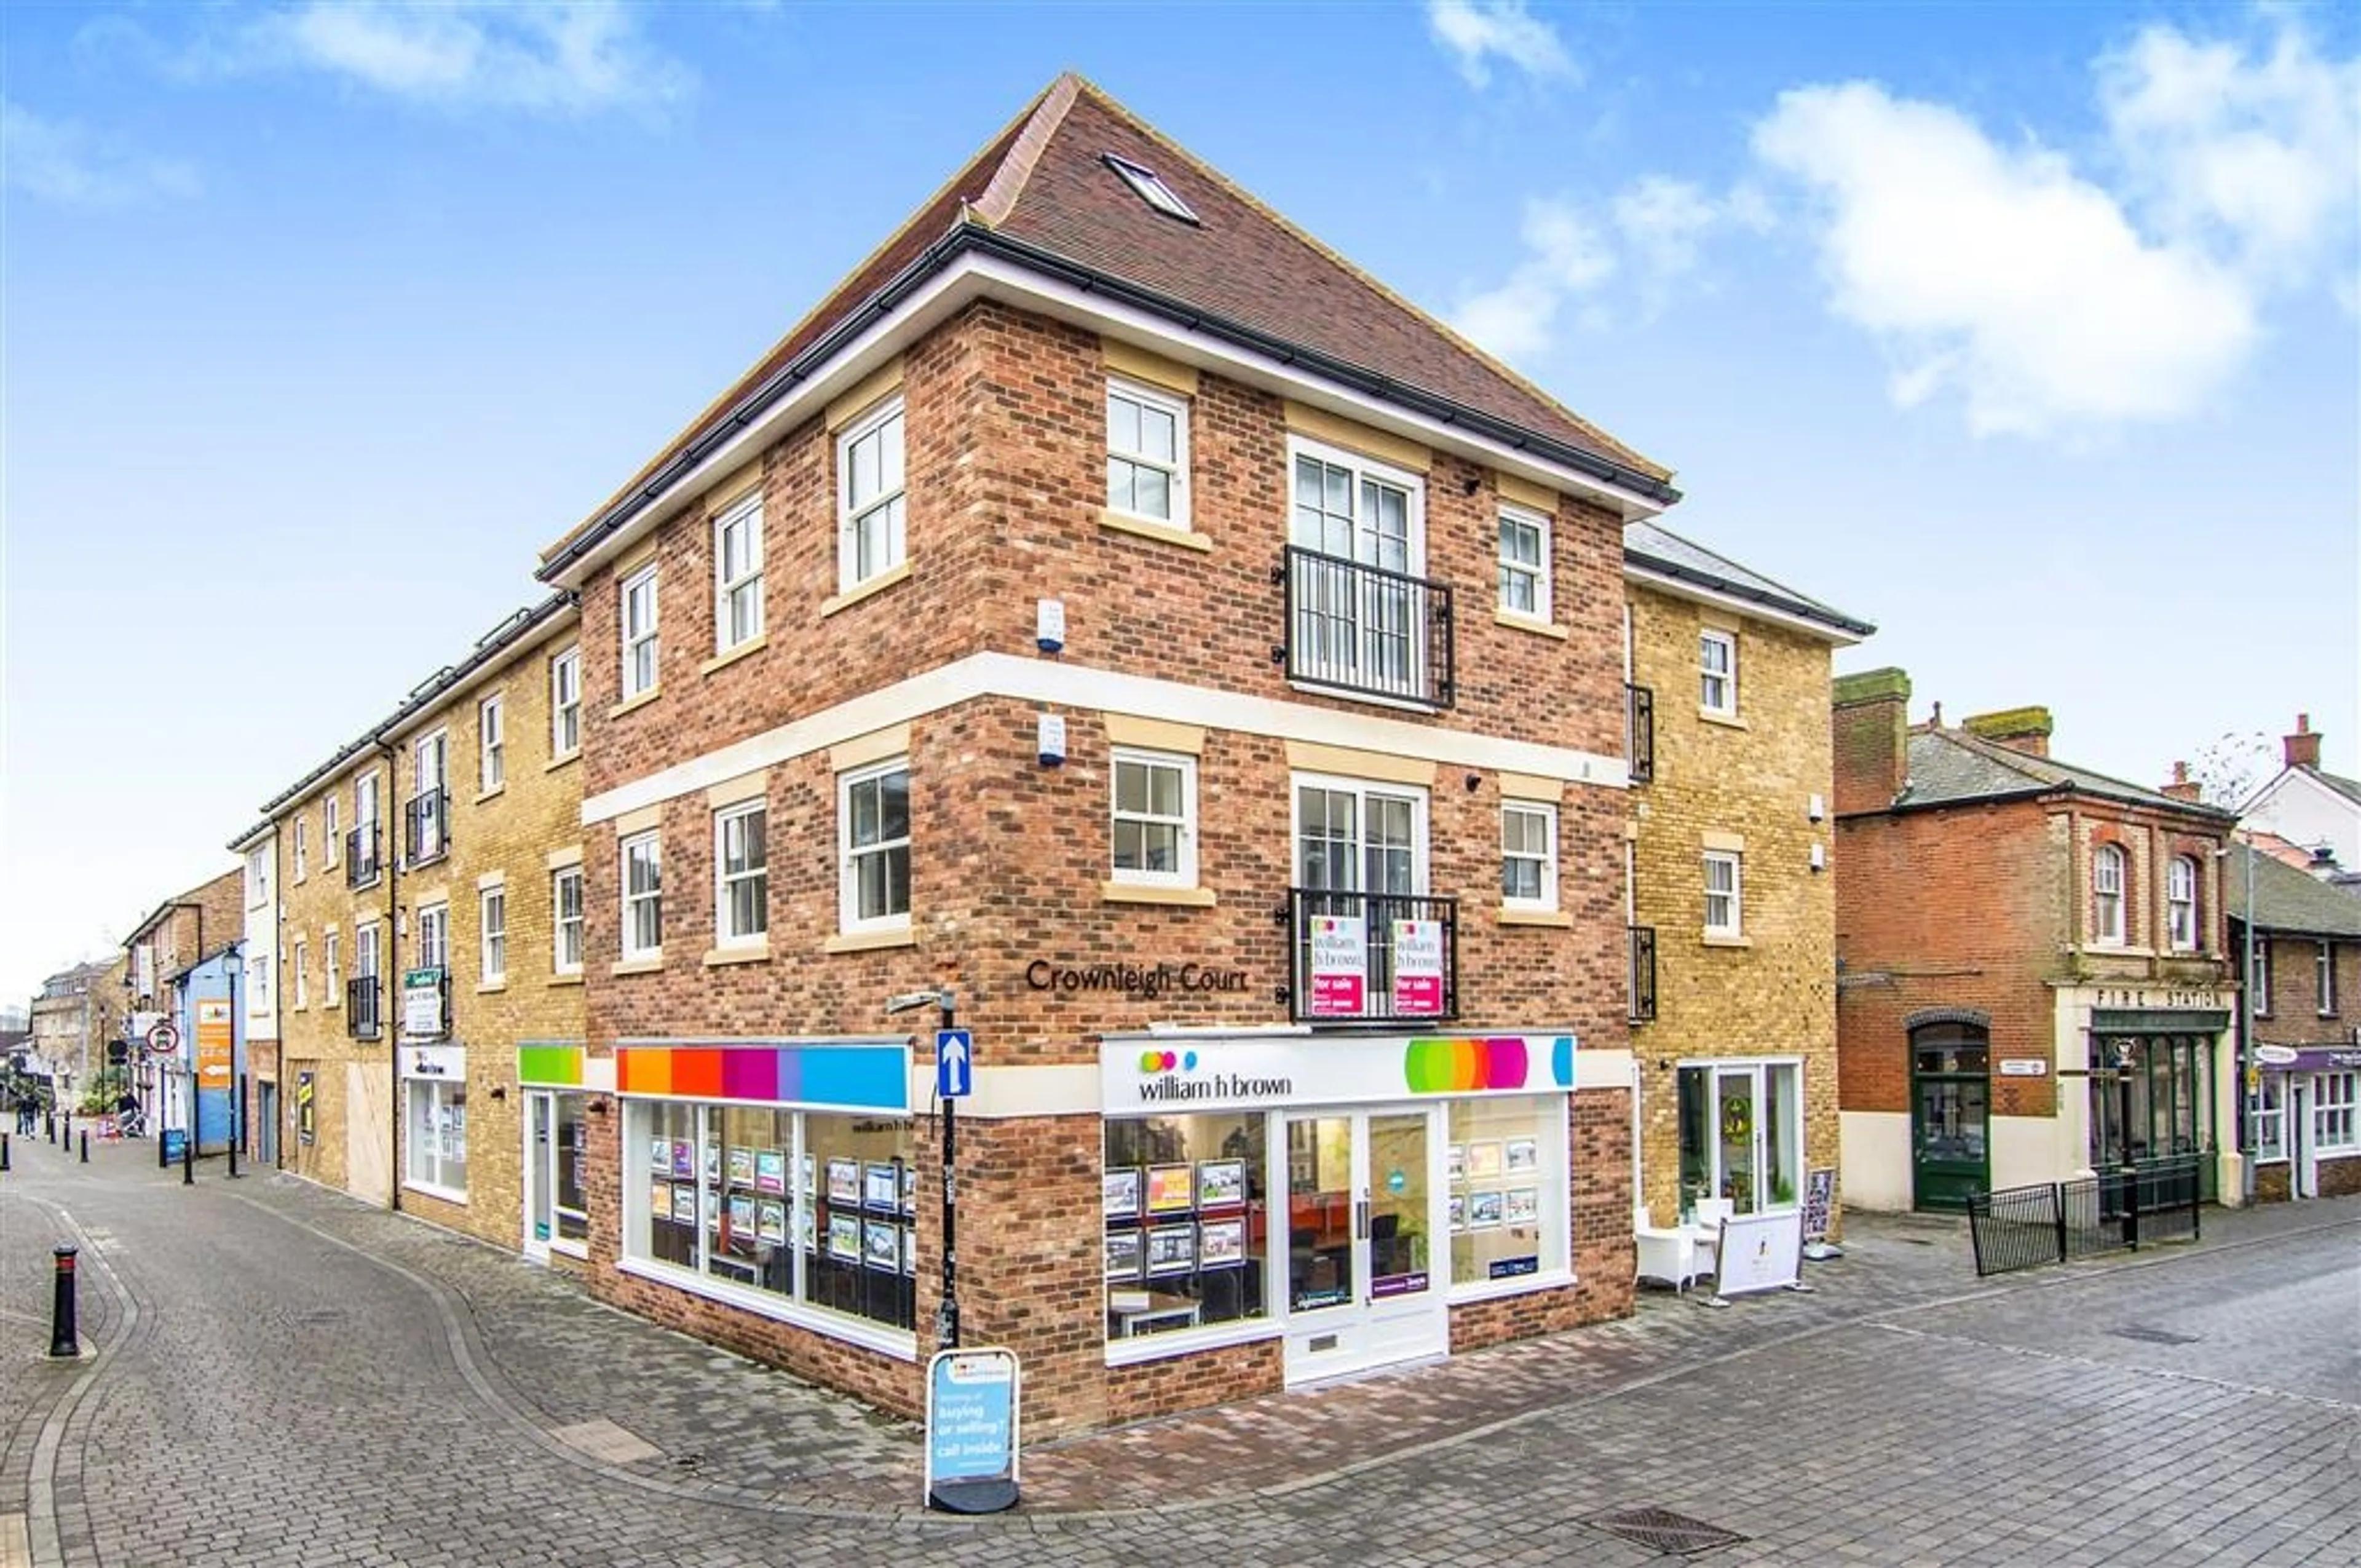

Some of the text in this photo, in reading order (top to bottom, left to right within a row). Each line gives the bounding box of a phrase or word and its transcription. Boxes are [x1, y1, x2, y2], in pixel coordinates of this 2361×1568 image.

[1026, 959, 1250, 999] Crownleigh Court
[1315, 976, 1352, 990] for sale
[1396, 977, 1431, 990] for sale
[2098, 989, 2223, 1008] FIRE STATION
[1139, 1072, 1292, 1101] william h brown
[938, 1406, 984, 1420] buying
[938, 1424, 952, 1436] or
[938, 1443, 960, 1458] call
